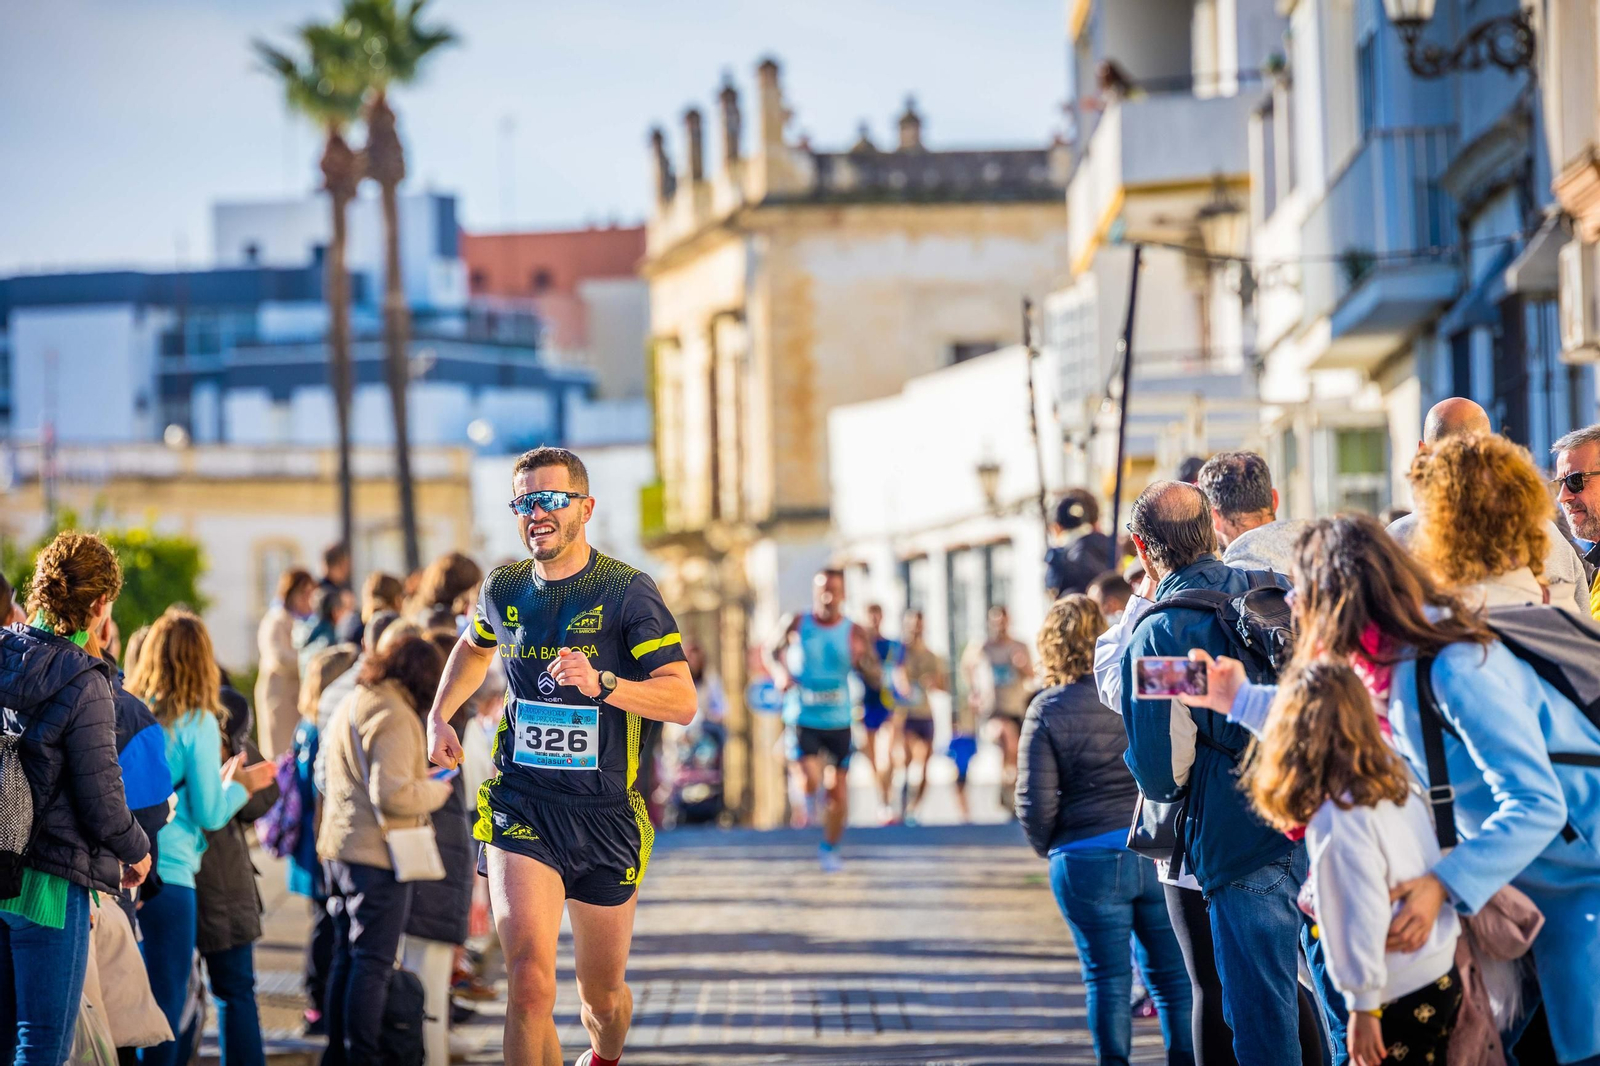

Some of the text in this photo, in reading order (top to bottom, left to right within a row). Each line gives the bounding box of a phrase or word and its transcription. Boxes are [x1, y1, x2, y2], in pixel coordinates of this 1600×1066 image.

[521, 645, 538, 659] LA
[541, 645, 599, 659] BAOSA
[526, 726, 587, 752] 326
[537, 757, 566, 765] cajasur
